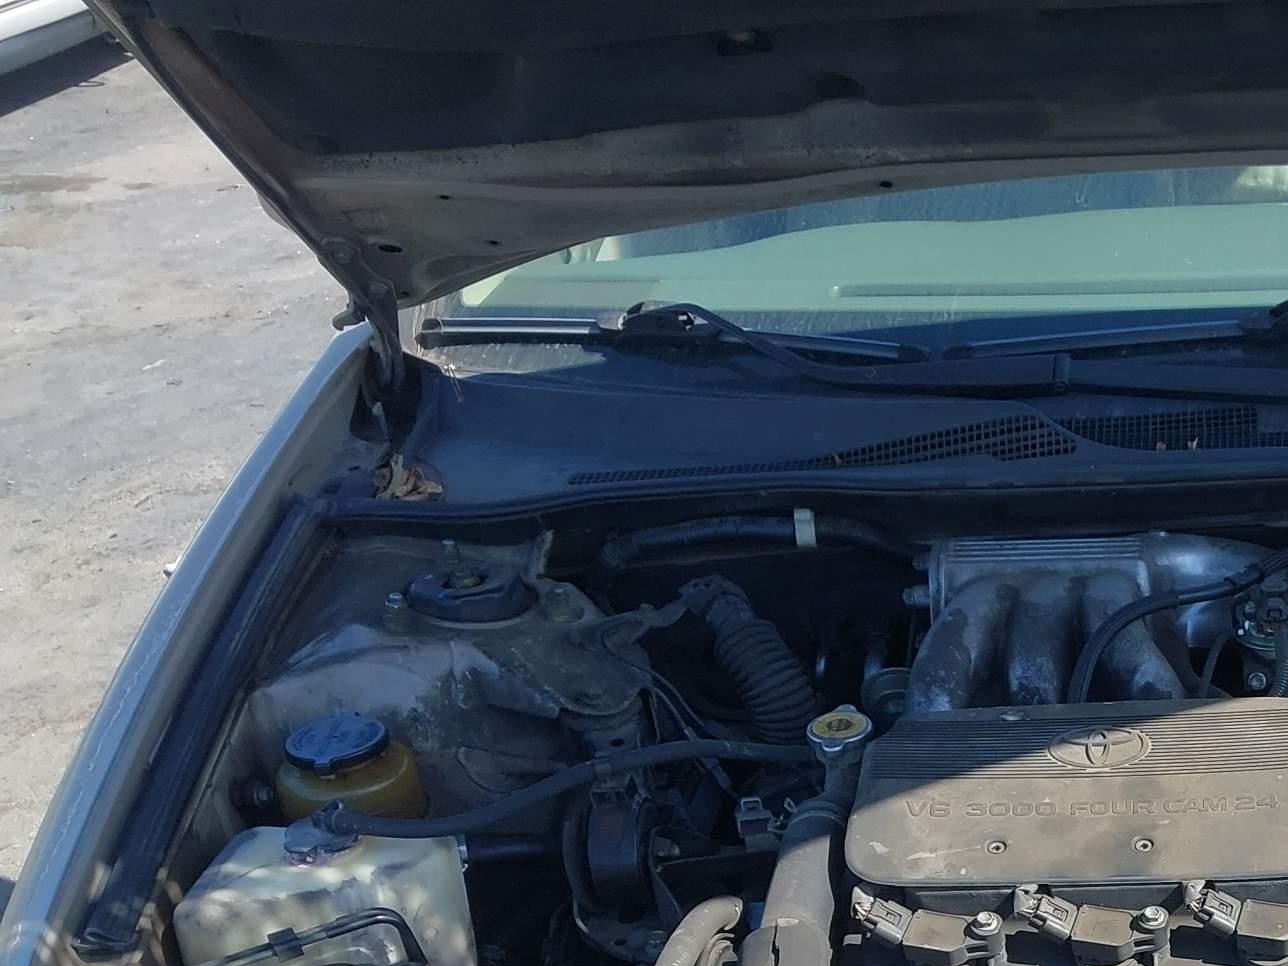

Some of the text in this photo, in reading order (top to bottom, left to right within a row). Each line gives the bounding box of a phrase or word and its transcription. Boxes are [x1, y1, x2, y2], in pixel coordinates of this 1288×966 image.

[905, 794, 1280, 818] V6 3000 FOUR CAM 24
